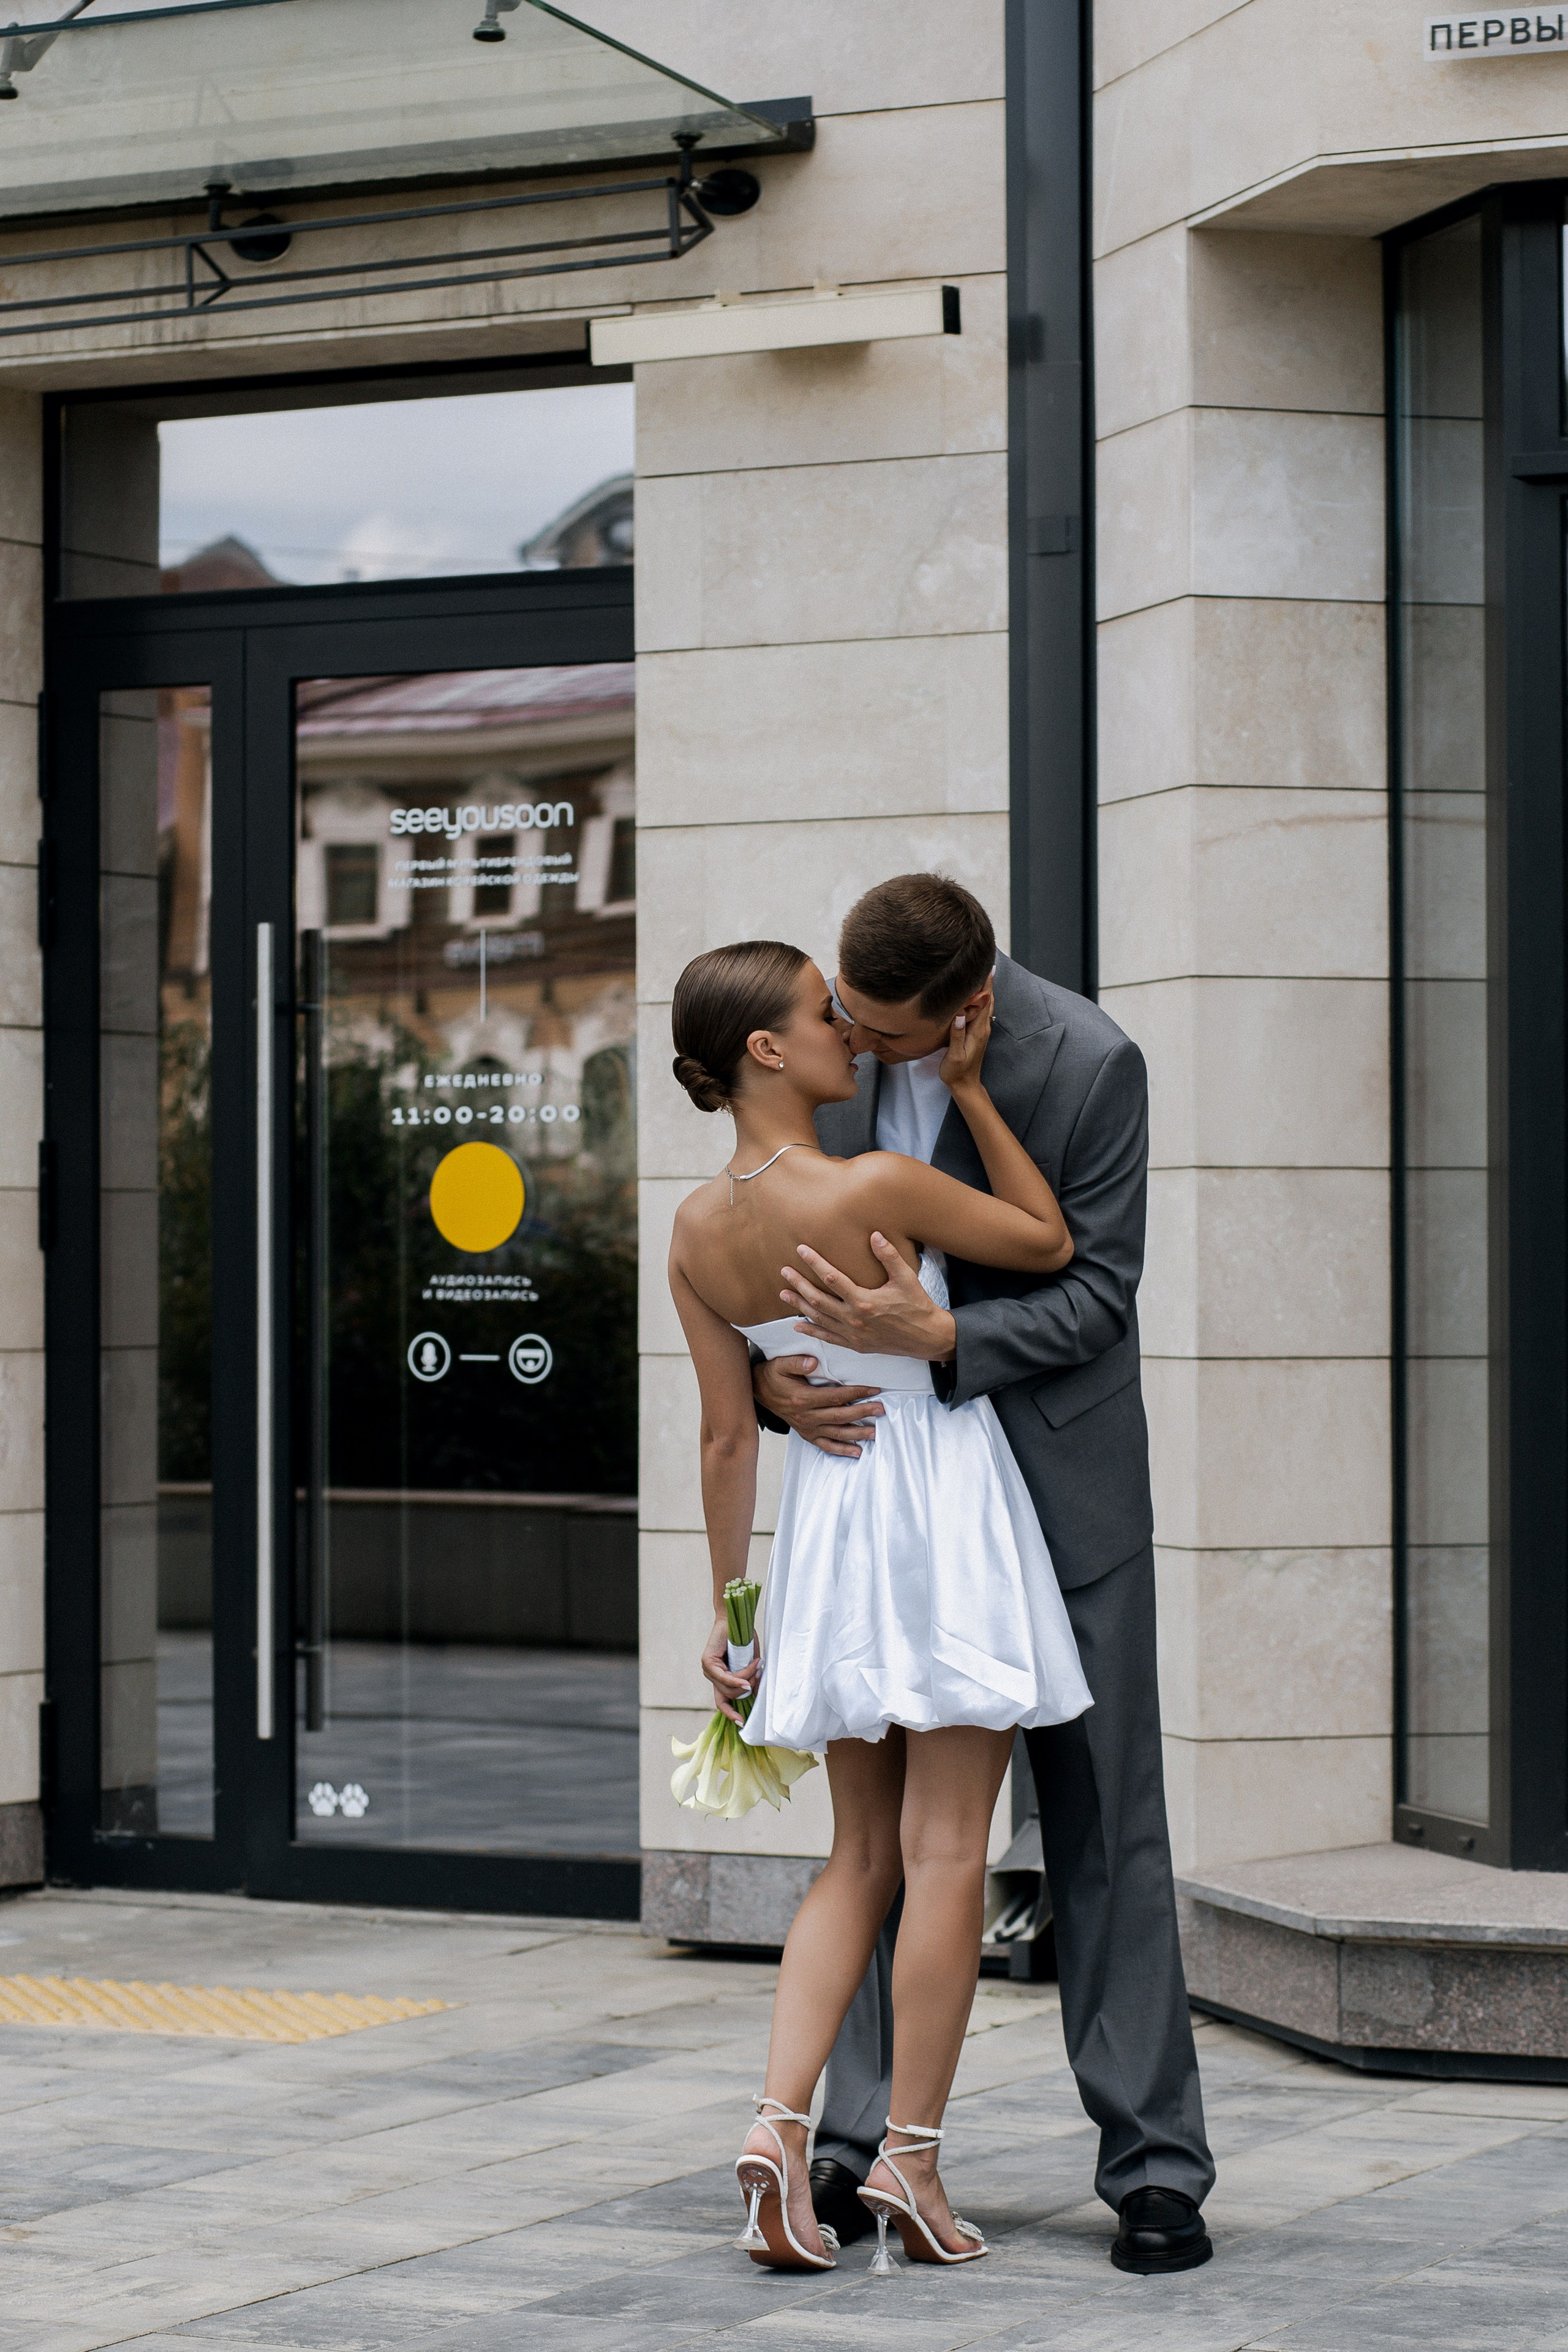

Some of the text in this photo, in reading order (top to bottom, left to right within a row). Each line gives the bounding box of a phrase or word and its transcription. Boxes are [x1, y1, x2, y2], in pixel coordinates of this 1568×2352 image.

[390, 801, 574, 840] seeyousoon
[424, 1072, 543, 1089] ЕЖЕДНЕВНО
[391, 1104, 581, 1126] 11:00-20:00
[429, 1275, 532, 1287] АУДИОЗАПИСЬ
[422, 1289, 539, 1302] И ВИДЕОЗАПИСЬ
